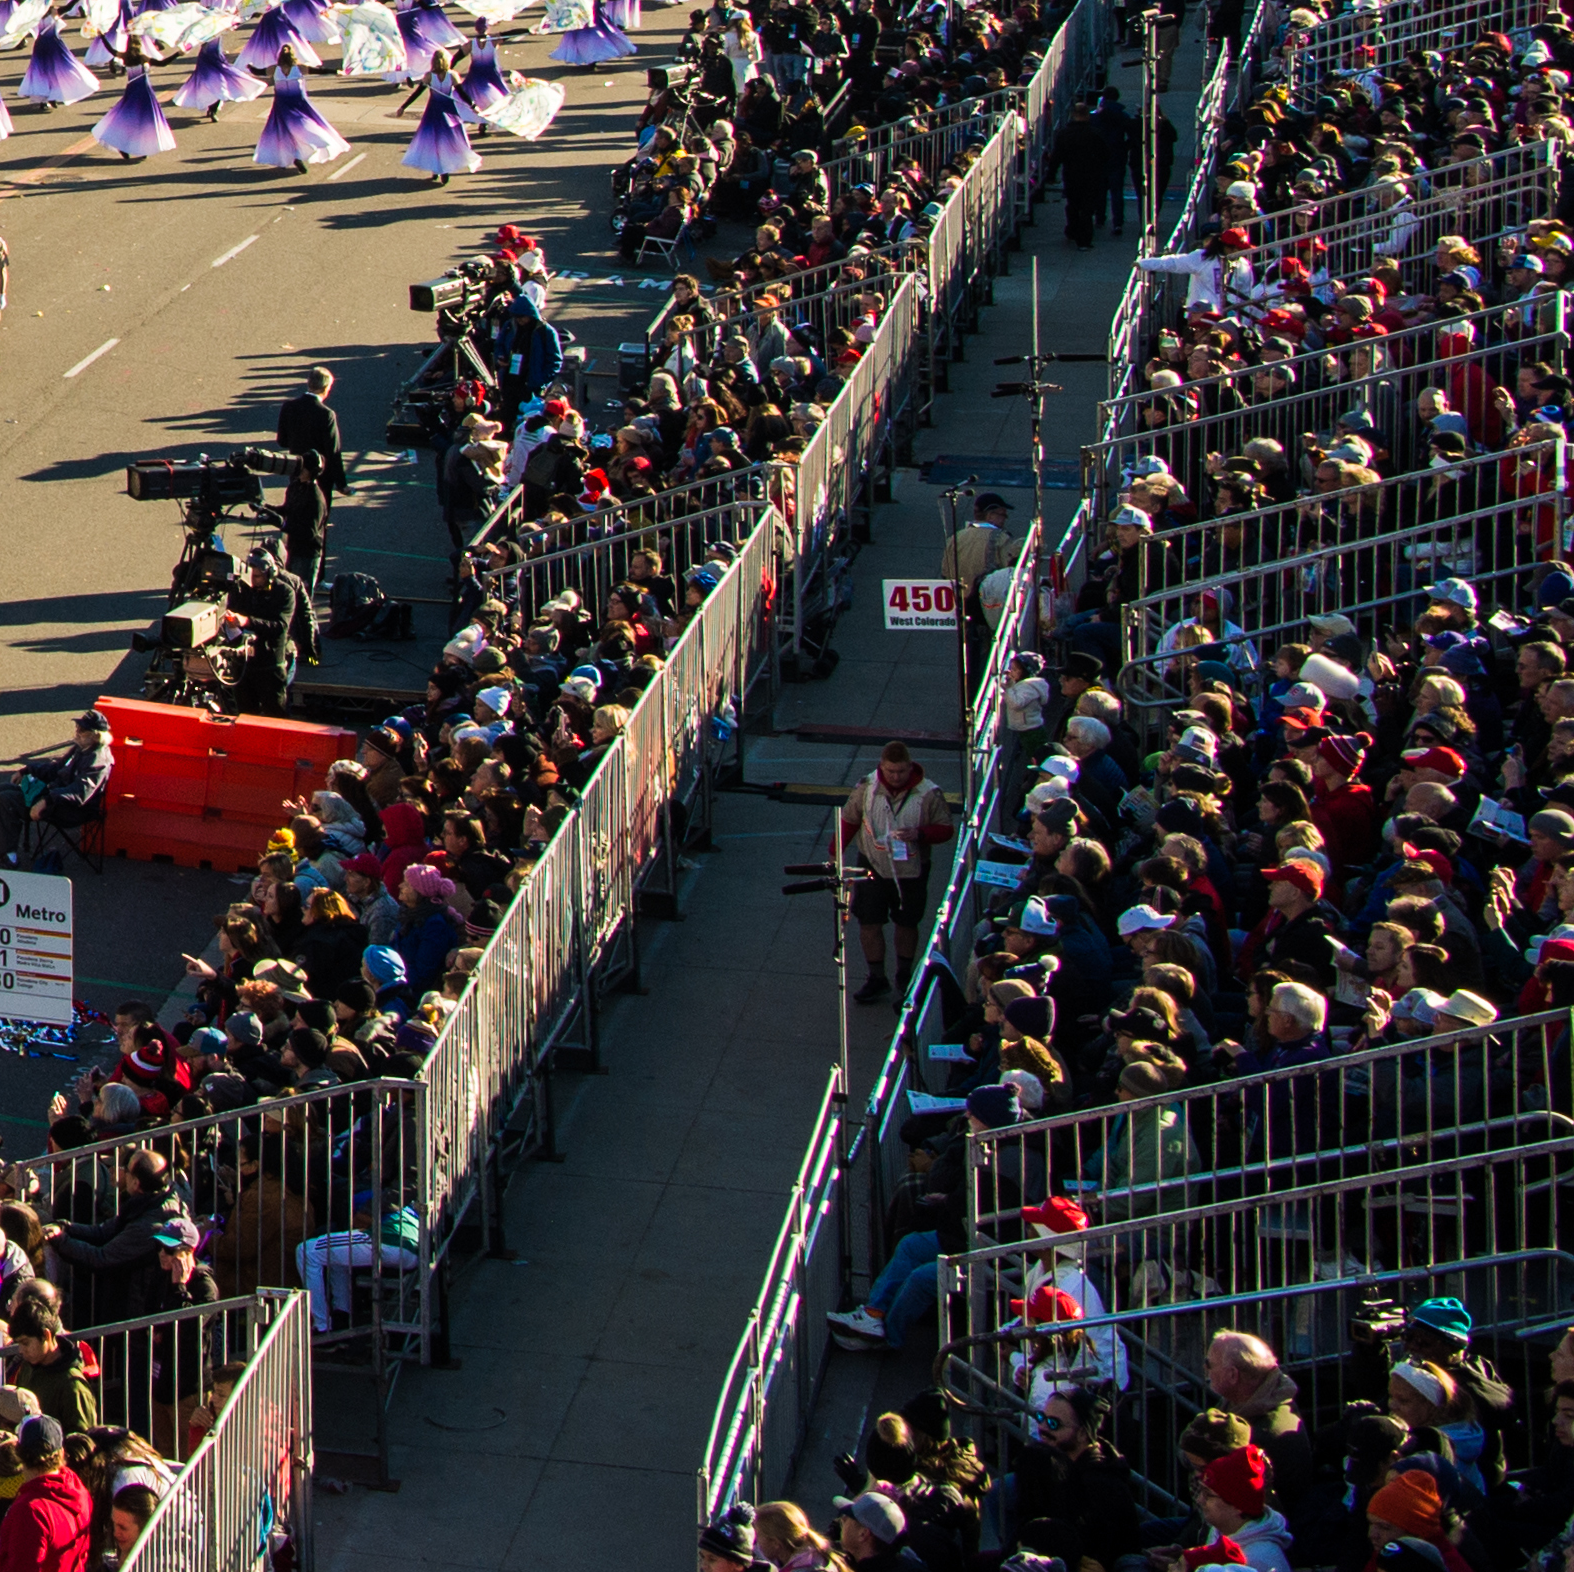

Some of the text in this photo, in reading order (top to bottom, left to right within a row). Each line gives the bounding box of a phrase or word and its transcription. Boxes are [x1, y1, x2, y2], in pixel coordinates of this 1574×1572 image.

[889, 585, 955, 612] 450
[889, 616, 956, 626] West Colorado
[15, 903, 66, 923] Metro
